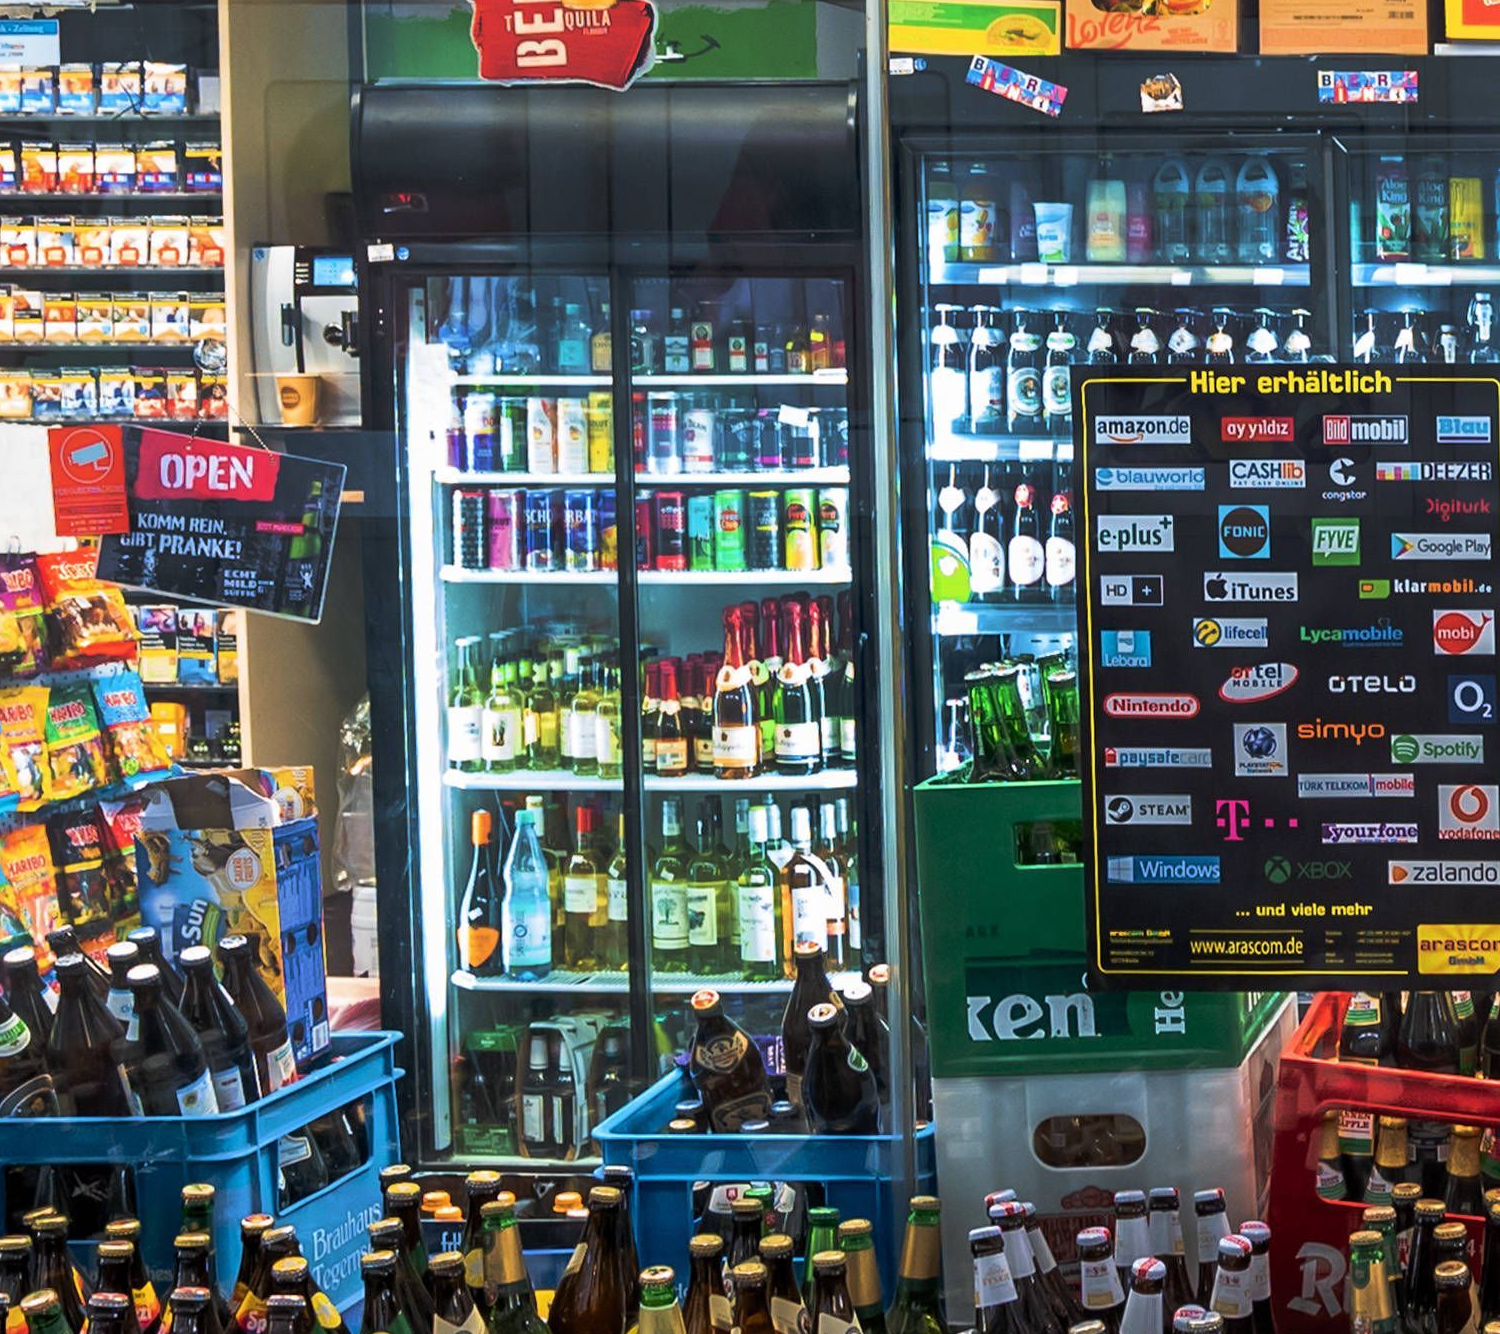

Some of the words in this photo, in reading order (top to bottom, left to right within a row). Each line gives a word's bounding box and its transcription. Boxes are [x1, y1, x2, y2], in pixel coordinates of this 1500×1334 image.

[1068, 12, 1161, 50] Lorenz
[1380, 190, 1408, 204] King
[1190, 370, 1246, 394] Hier
[1257, 370, 1393, 394] erhältlich
[1097, 417, 1190, 437] amazon.de
[1227, 424, 1245, 438] ay
[1326, 417, 1348, 442] Bild
[1351, 418, 1406, 441] mobil
[1438, 417, 1489, 435] Blau
[160, 453, 254, 491] OPEN
[1116, 469, 1204, 485] blauworld
[1421, 463, 1492, 481] DEEZER
[1322, 489, 1367, 503] congstar
[137, 512, 186, 532] KOMM
[191, 516, 228, 536] REIN.
[1224, 525, 1266, 539] FONIC
[120, 533, 156, 548] GIBT
[158, 533, 243, 561] PRANKE!
[1316, 528, 1355, 552] FYVE
[1417, 538, 1462, 556] Google
[1464, 538, 1491, 556] Play
[223, 569, 257, 579] ECHT
[223, 579, 257, 589] MILD
[1230, 584, 1296, 601] iTunes
[1394, 578, 1493, 595] klarmobil.de
[1224, 625, 1268, 641] lifecell
[1300, 625, 1403, 644] Lycamobile
[1104, 653, 1149, 667] Lebara
[1231, 663, 1283, 680] ortel
[1232, 679, 1283, 688] MOBILE
[49, 701, 86, 721] HARIBO
[1112, 698, 1191, 714] Nintendo
[1298, 718, 1385, 746] simyo
[1118, 749, 1210, 768] paysafecard
[1422, 741, 1481, 760] Spotify
[1299, 780, 1324, 792] TÜRK
[1324, 780, 1369, 792] TELEKOM
[1374, 777, 1414, 791] mobile
[1138, 804, 1187, 817] STEAM
[1332, 823, 1419, 843] yourfone
[1438, 827, 1500, 841] vodafone
[7, 853, 46, 877] HARIBO
[1139, 860, 1221, 881] Windows
[1298, 862, 1353, 881] XBOX
[1412, 862, 1499, 883] zalando
[1256, 903, 1287, 917] und
[1291, 903, 1327, 917] viele
[1331, 903, 1373, 917] mehr
[1190, 935, 1304, 957] www.arascom.de
[312, 1198, 382, 1253] Brauhaus
